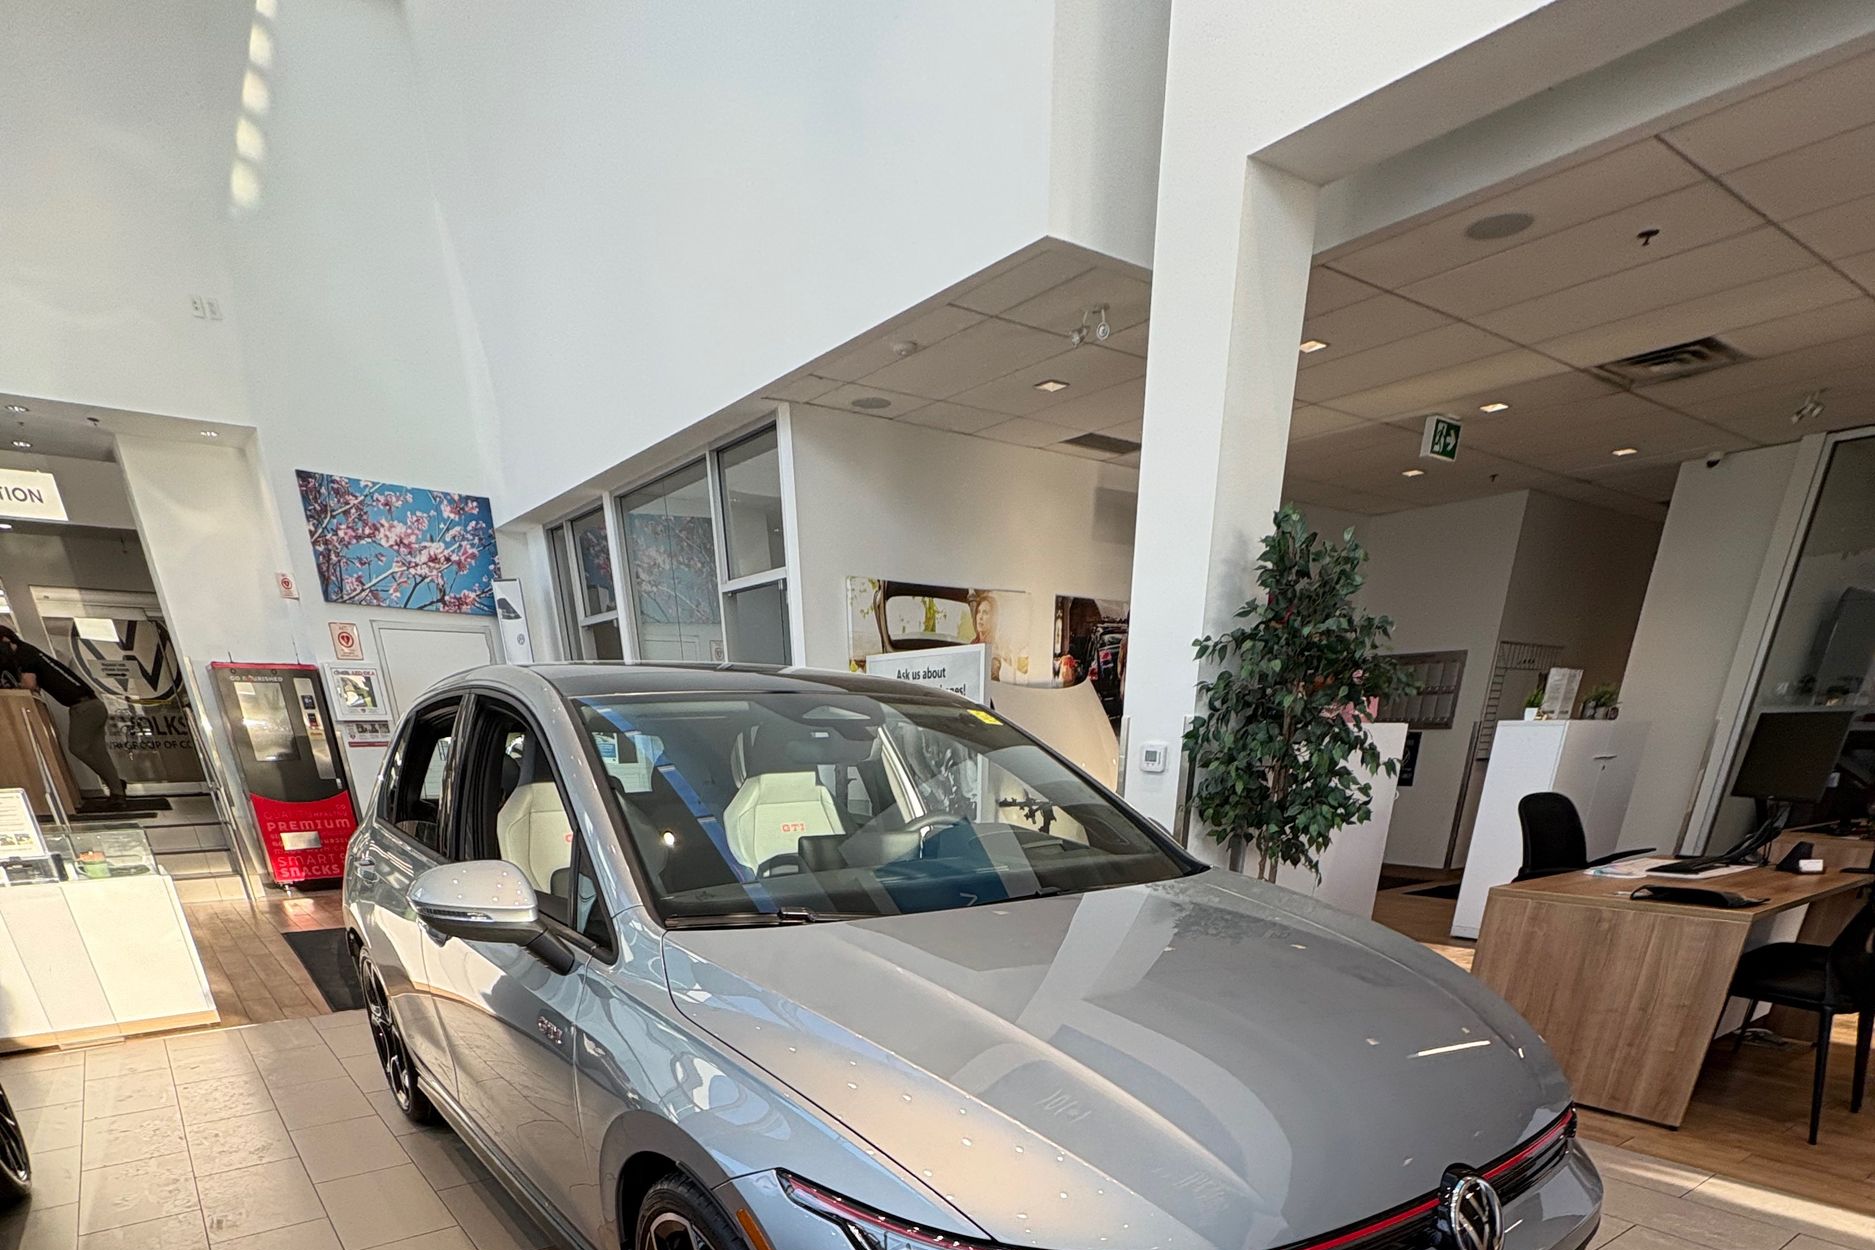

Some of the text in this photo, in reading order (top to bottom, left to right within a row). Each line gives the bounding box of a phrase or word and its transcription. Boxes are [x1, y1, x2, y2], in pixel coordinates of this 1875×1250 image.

[897, 665, 946, 680] Ask us about
[267, 819, 351, 831] PREMIUM
[782, 823, 805, 832] GTI
[280, 864, 340, 878] SNACKS
